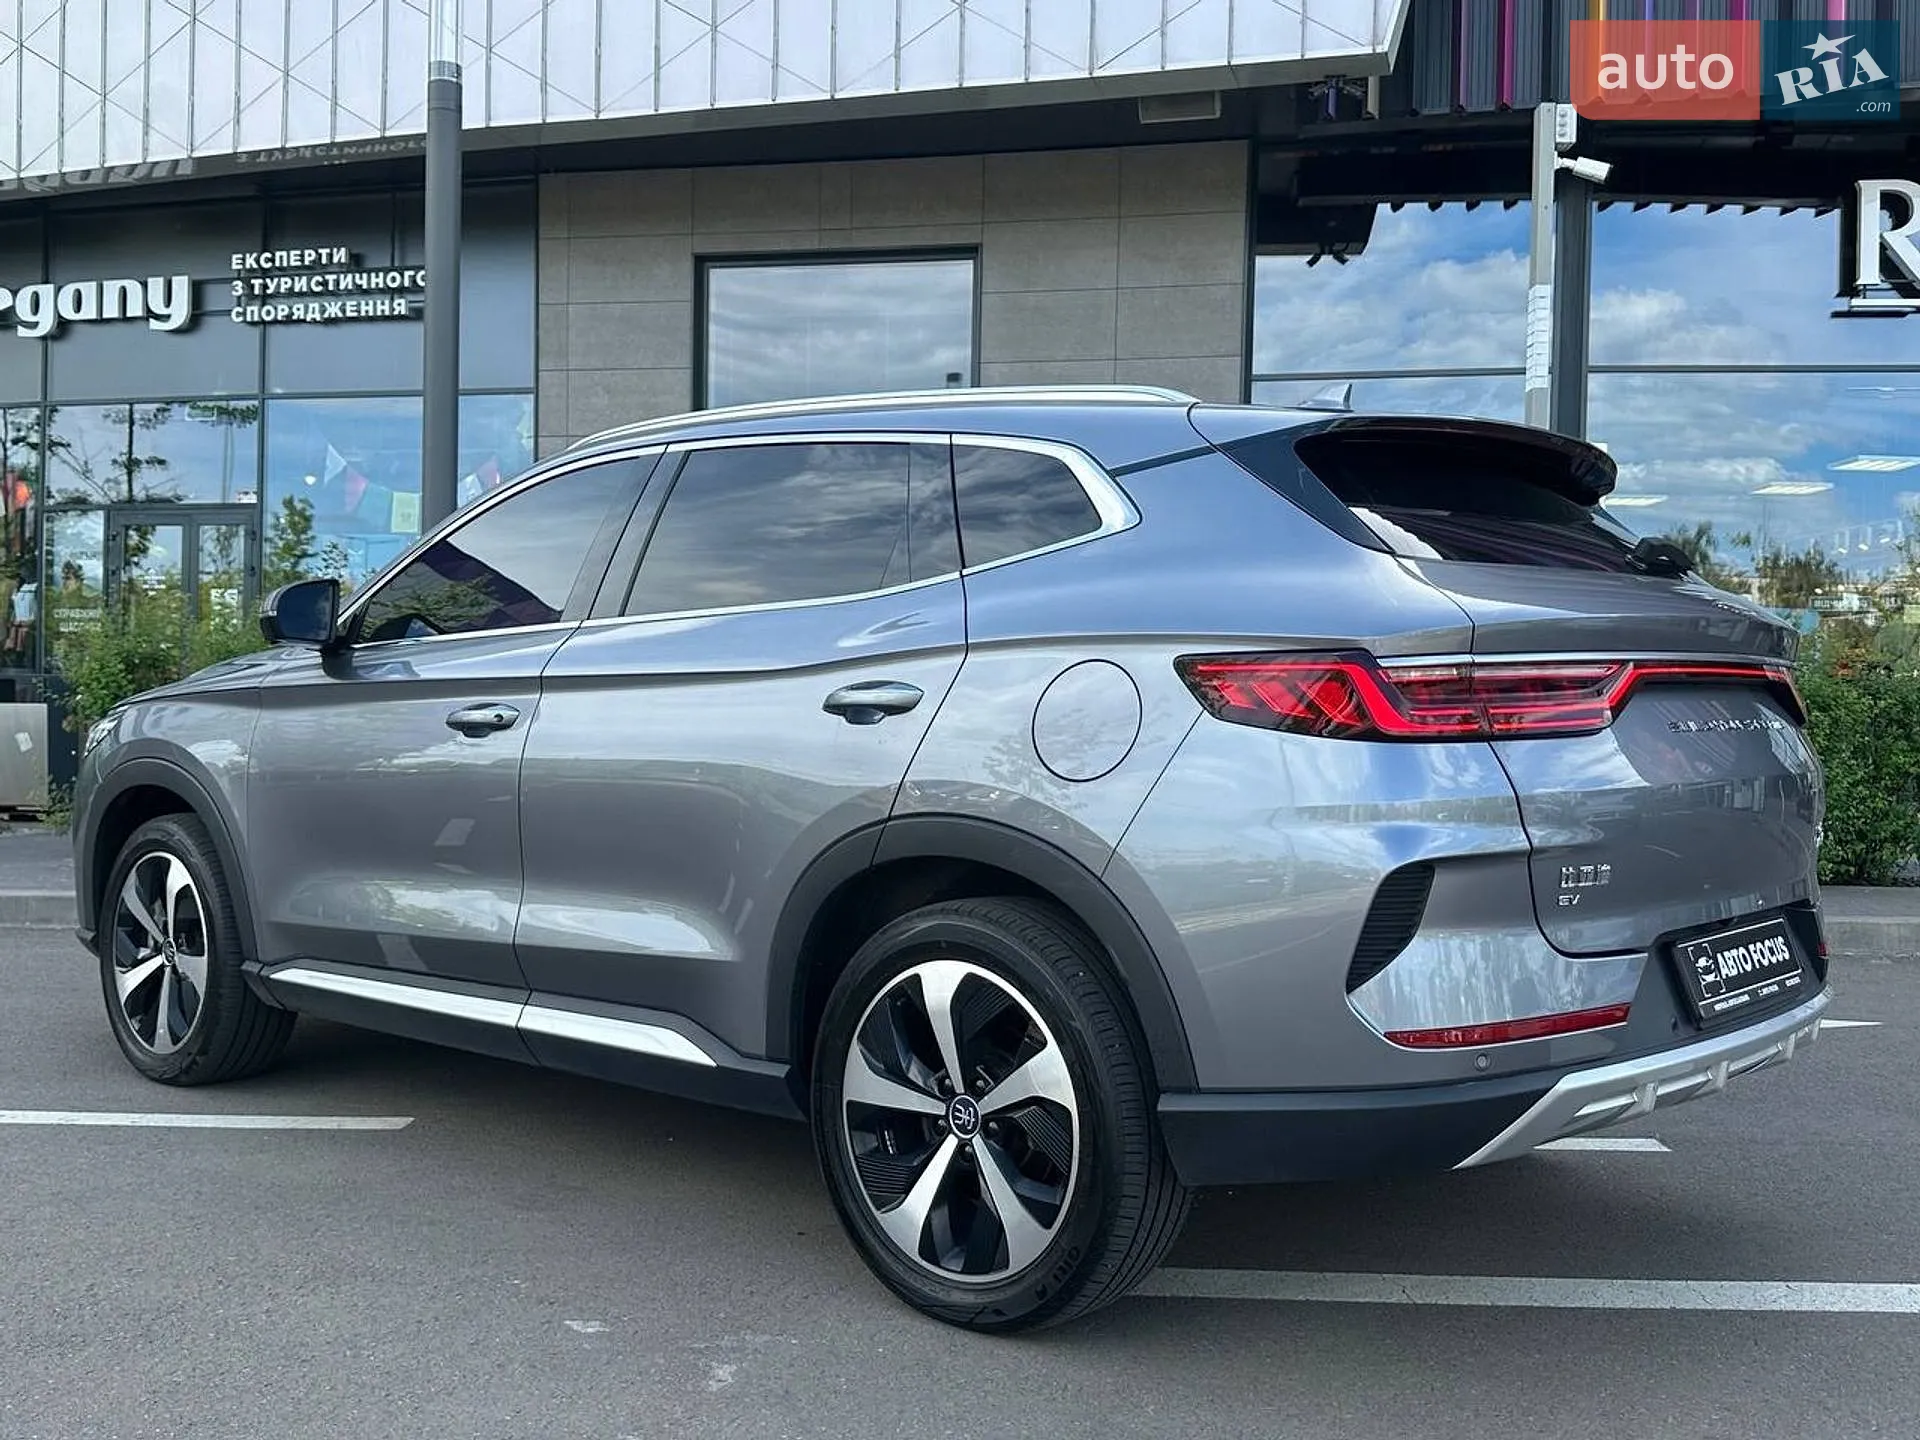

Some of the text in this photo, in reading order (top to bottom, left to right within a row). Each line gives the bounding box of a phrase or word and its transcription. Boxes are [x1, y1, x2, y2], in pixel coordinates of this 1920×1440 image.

[231, 247, 347, 270] ЕКСПЕРТИ
[231, 280, 243, 296] З
[230, 299, 408, 323] СПОРЯДЖЕННЯ
[1748, 935, 1790, 969] FOCUS
